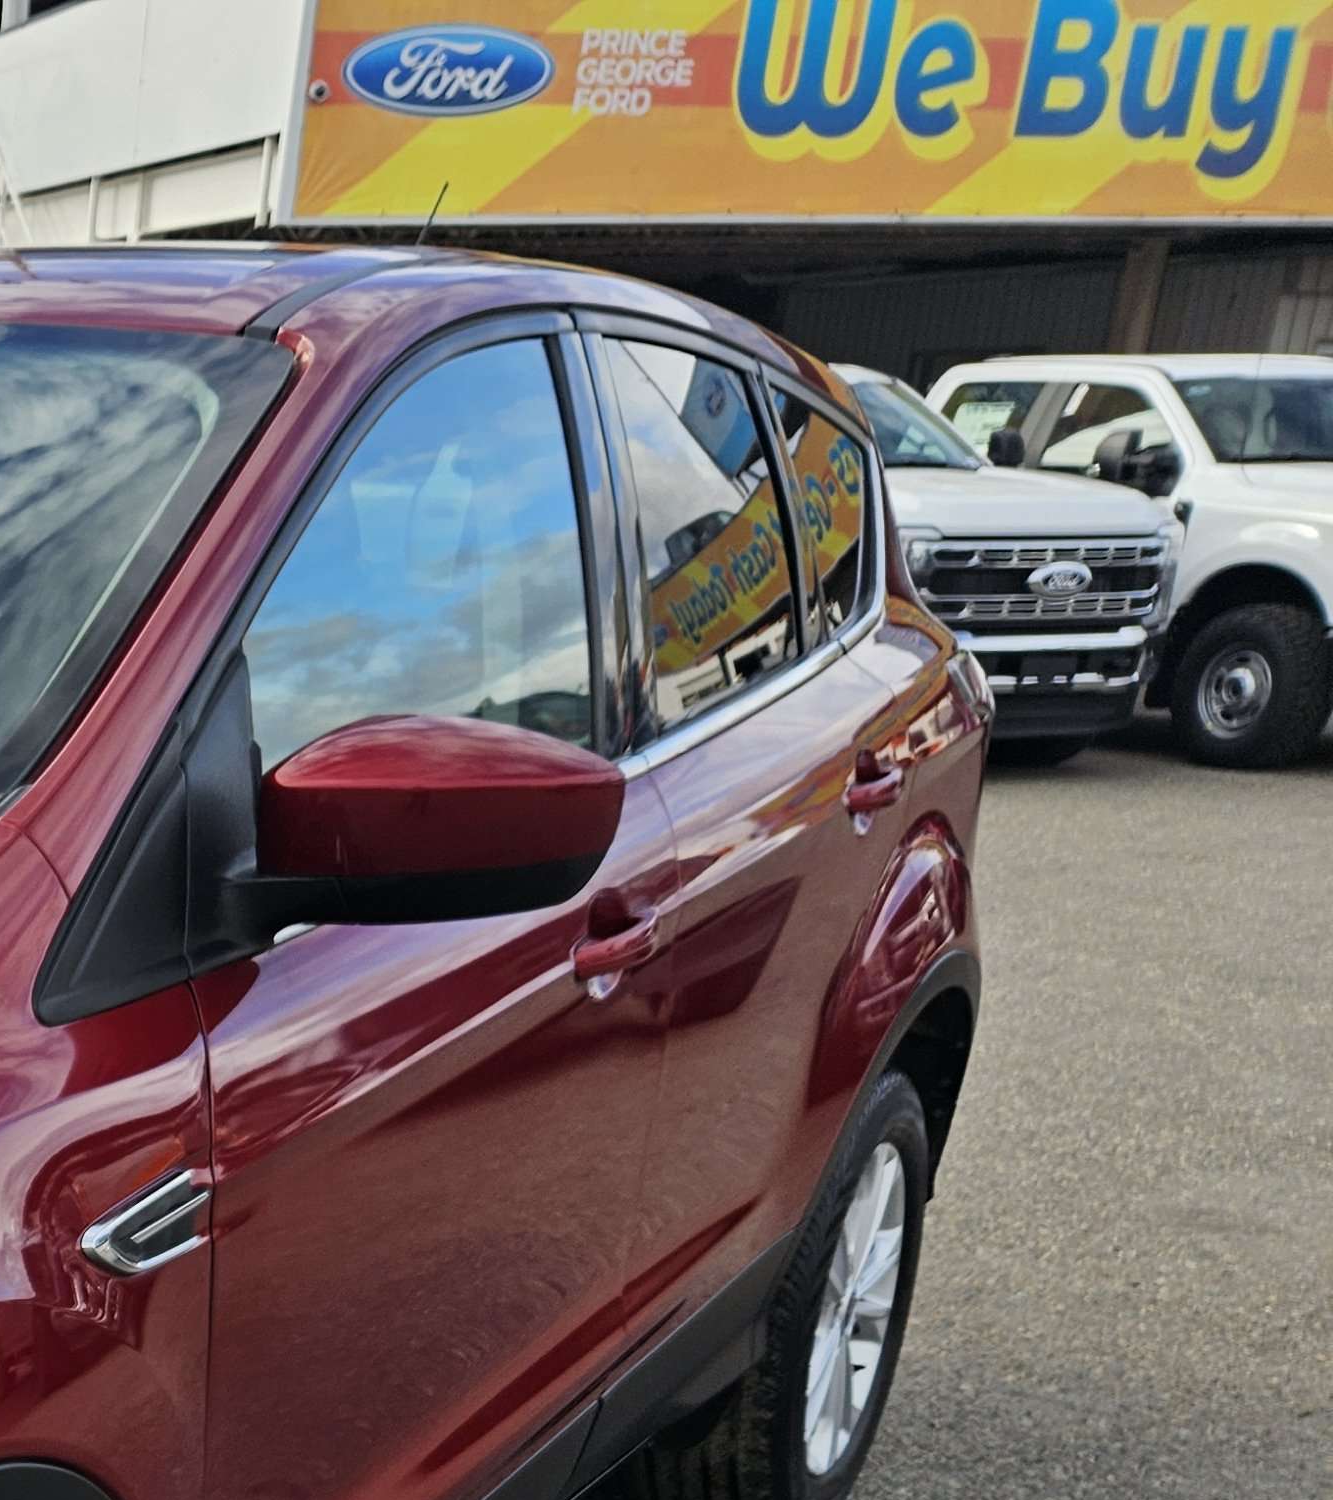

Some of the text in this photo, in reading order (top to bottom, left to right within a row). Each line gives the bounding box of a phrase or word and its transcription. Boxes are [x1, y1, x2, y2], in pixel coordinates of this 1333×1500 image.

[580, 27, 687, 57] PRINCE
[383, 38, 513, 100] Ford
[576, 57, 694, 87] GEORGE
[571, 88, 652, 116] FORD
[737, 0, 1297, 179] We Buy
